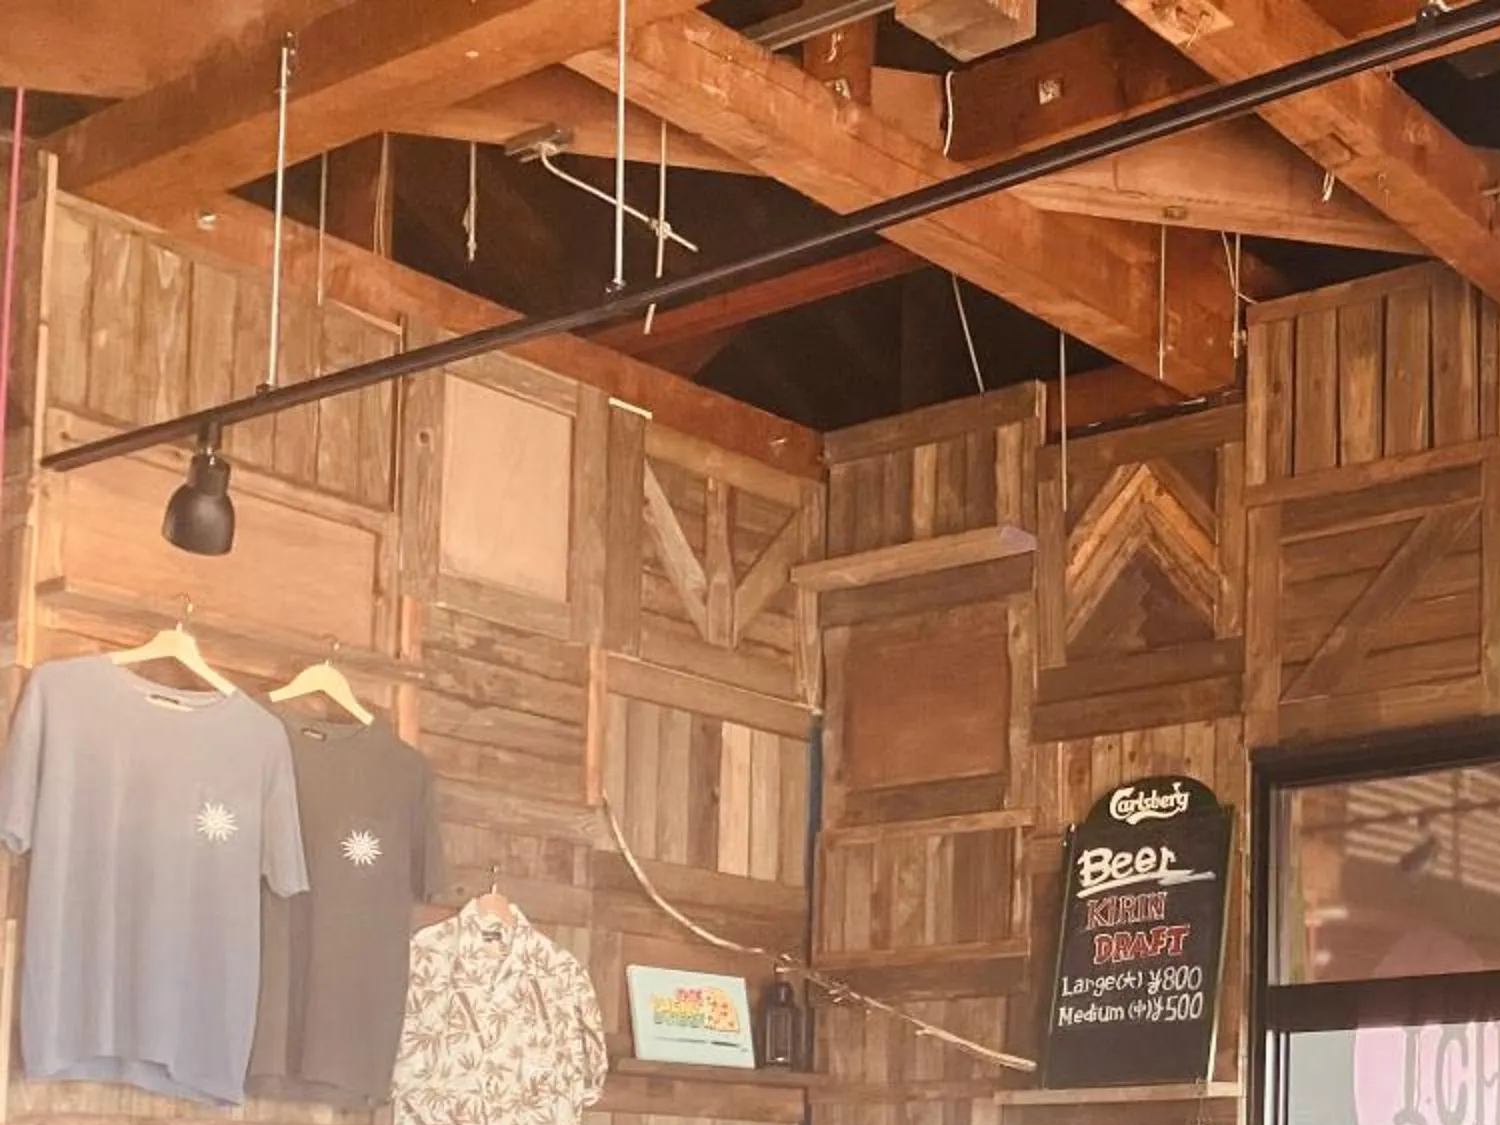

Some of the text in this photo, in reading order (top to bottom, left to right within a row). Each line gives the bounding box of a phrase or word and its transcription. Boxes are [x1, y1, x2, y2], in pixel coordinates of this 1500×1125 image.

[1110, 783, 1190, 822] Carlsberg
[1078, 847, 1177, 887] Beer
[1086, 891, 1168, 930] KIRIN
[1094, 925, 1190, 965] DRAFT
[1058, 1002, 1125, 1027] Medium
